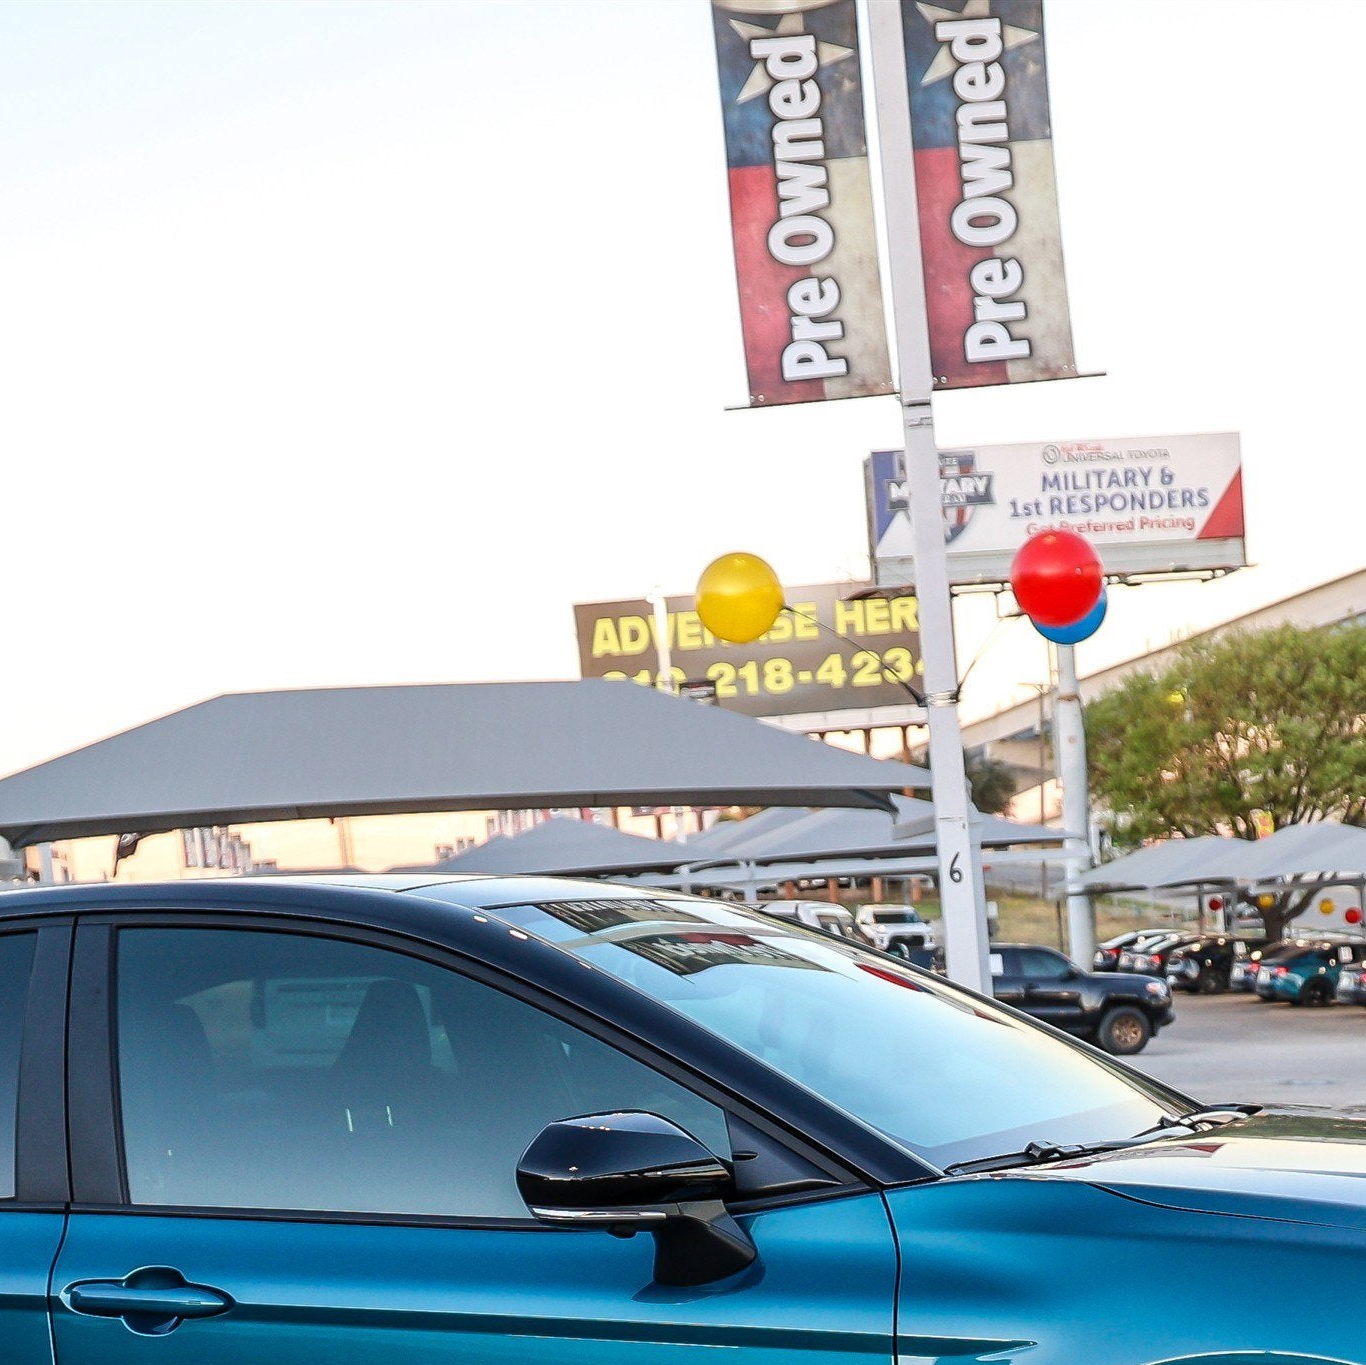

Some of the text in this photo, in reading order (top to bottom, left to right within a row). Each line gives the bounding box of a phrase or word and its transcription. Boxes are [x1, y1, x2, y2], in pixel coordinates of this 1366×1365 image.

[936, 17, 1031, 363] Pre Owned
[750, 34, 850, 382] Pre Owned
[1127, 447, 1171, 459] TOYOTA
[889, 477, 988, 498] MTARY
[1041, 466, 1176, 492] MILITARY &
[1010, 487, 1210, 518] 1st RESPONDERS
[1140, 515, 1197, 532] Pricing
[835, 595, 919, 636] HER
[706, 646, 922, 698] 218-423
[949, 851, 962, 884] 6
